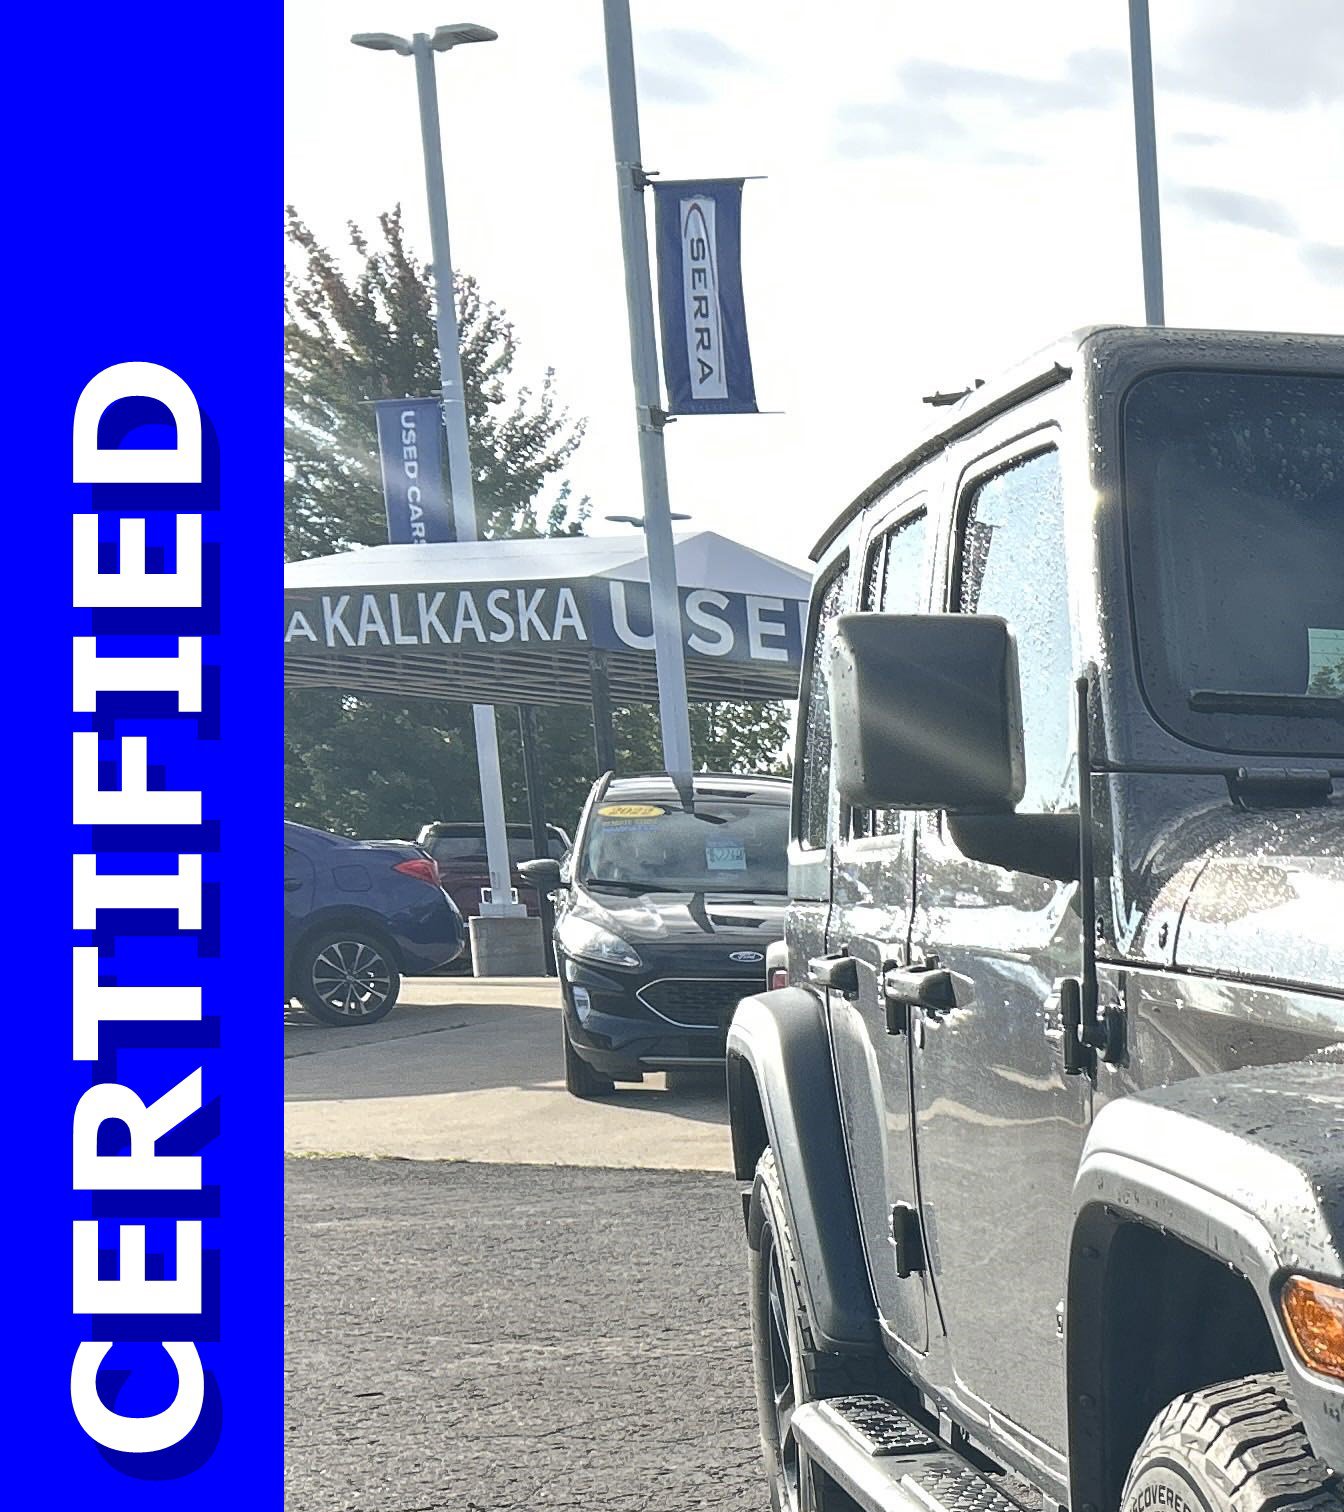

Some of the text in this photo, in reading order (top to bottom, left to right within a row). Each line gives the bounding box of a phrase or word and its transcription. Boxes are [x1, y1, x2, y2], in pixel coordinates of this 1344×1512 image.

[690, 237, 713, 385] SERRA
[401, 410, 427, 544] USED CAR
[322, 587, 588, 648] KALKASKA
[609, 580, 808, 662] USE
